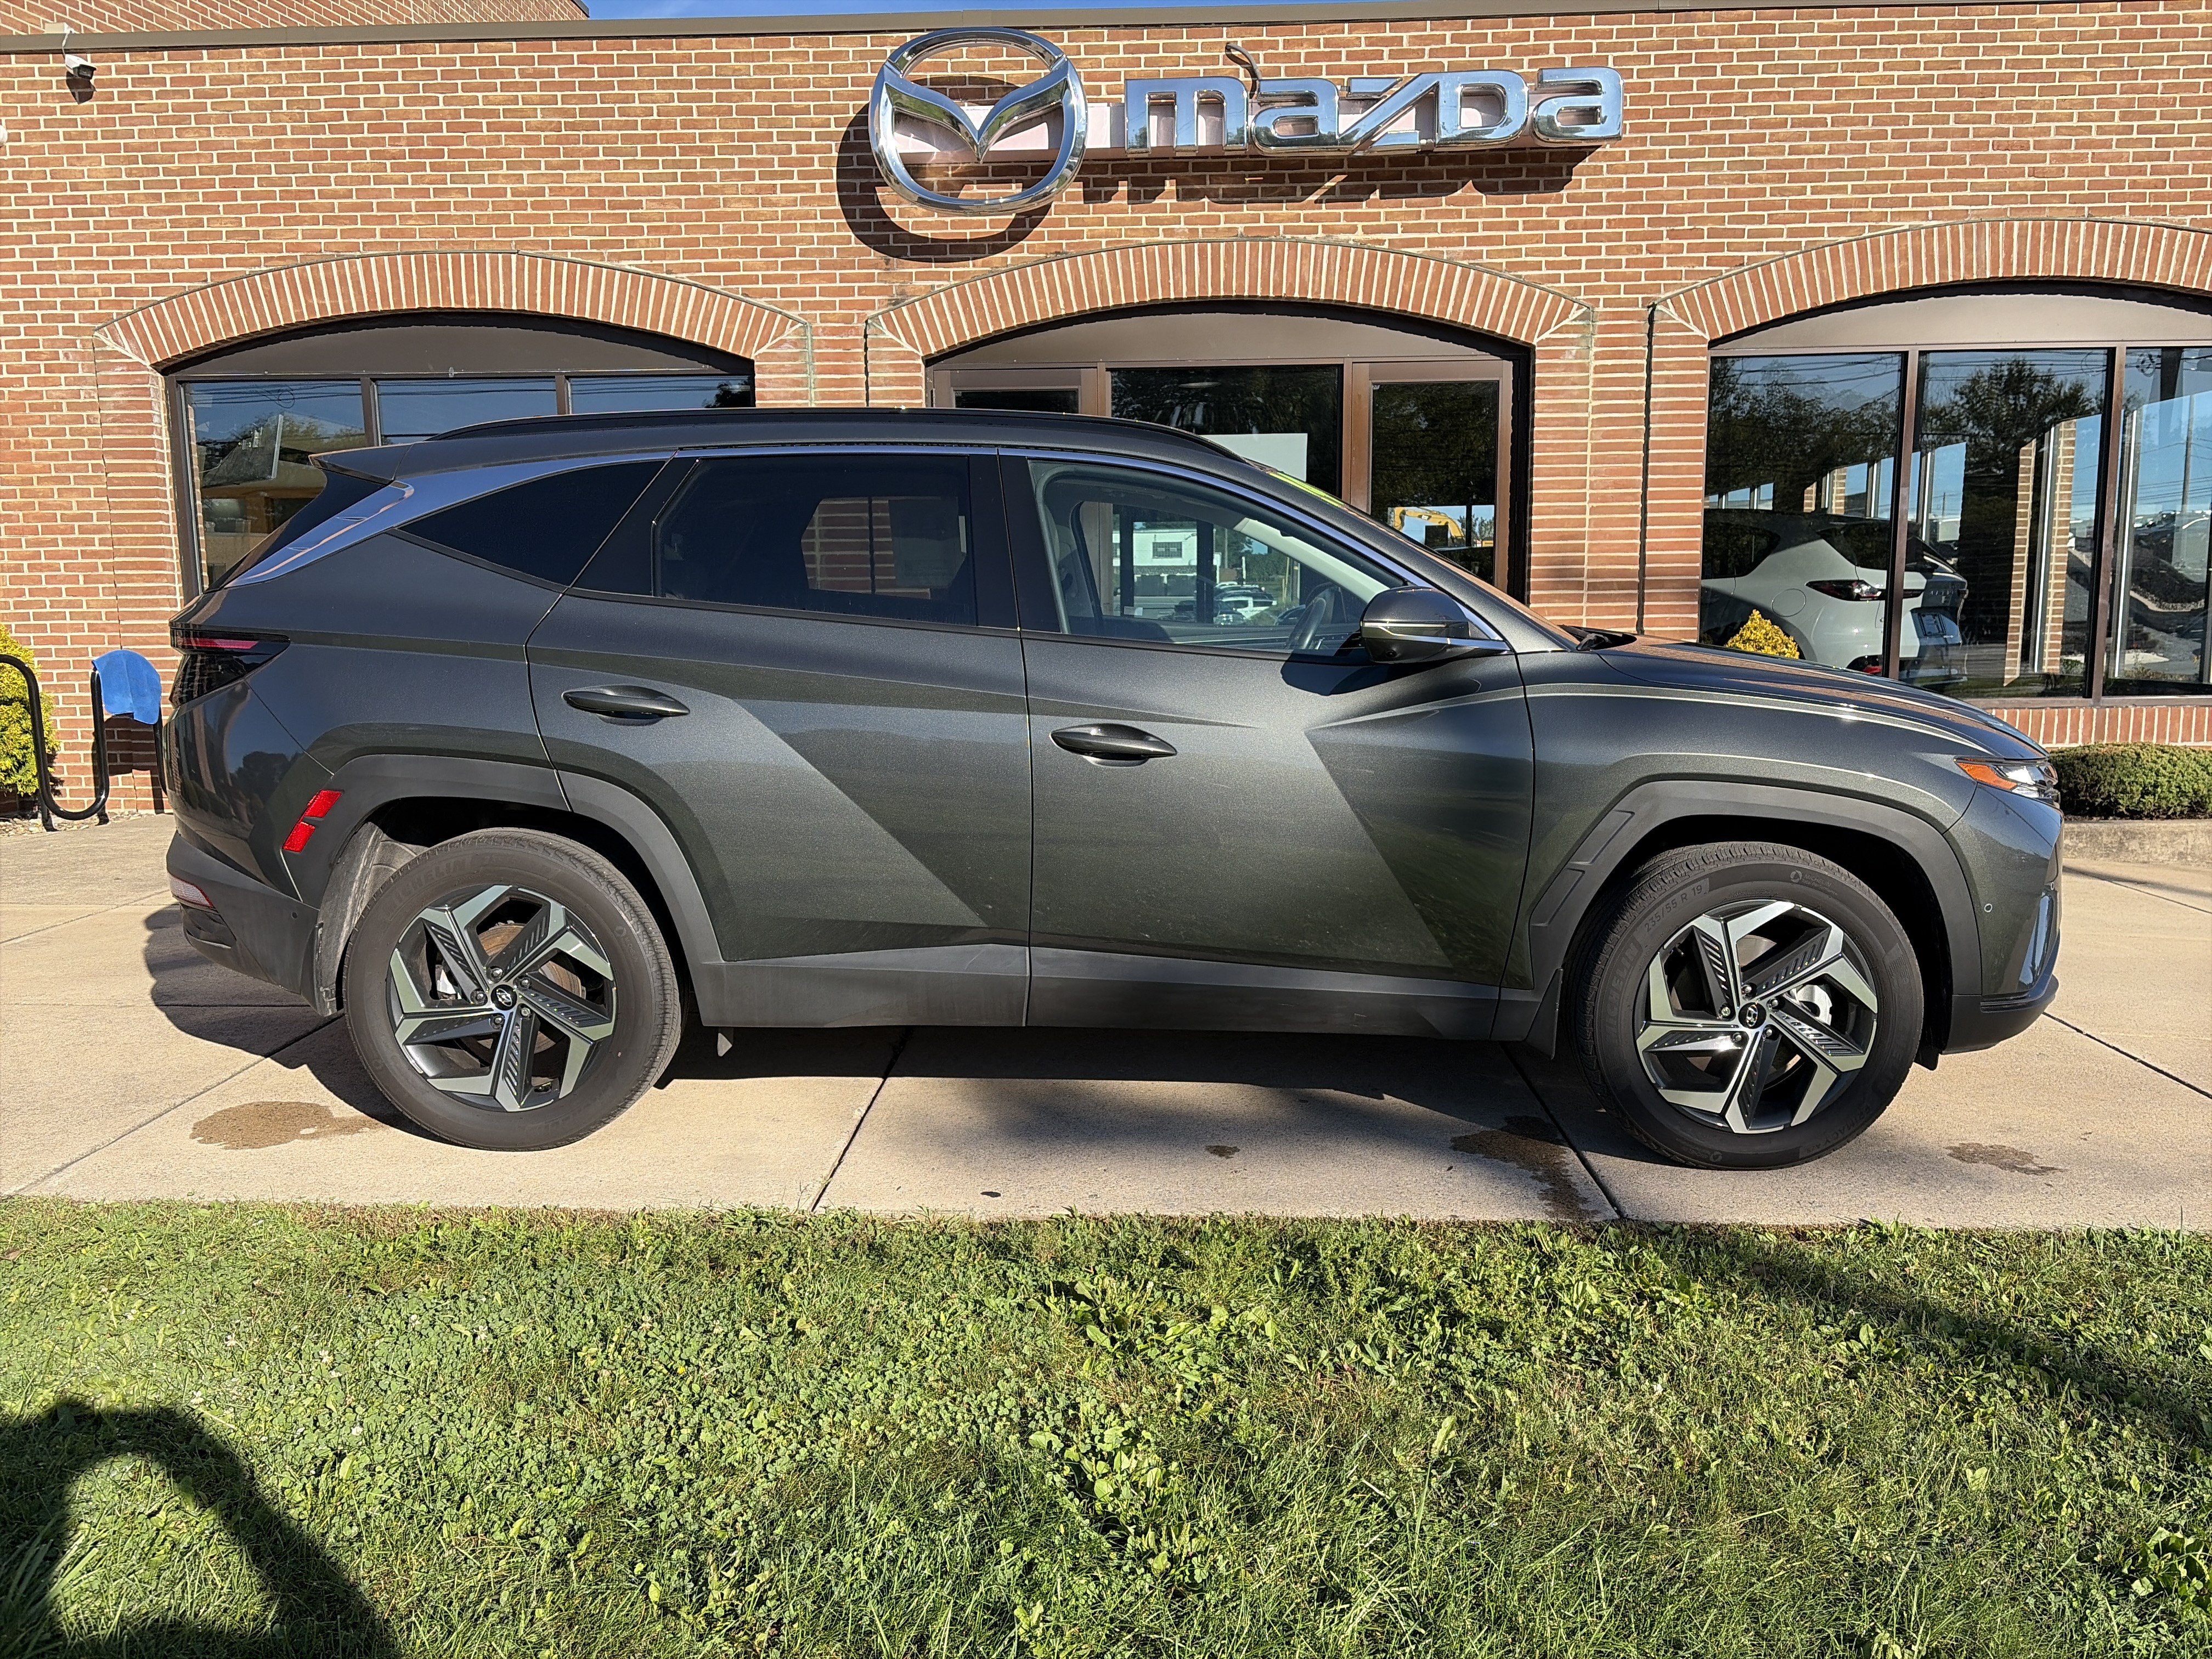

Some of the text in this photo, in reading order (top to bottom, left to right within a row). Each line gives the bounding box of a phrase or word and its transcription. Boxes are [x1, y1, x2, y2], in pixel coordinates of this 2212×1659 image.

[1644, 884, 1703, 933] 235/55 R 19
[1602, 941, 1641, 1036] MICHELIN
